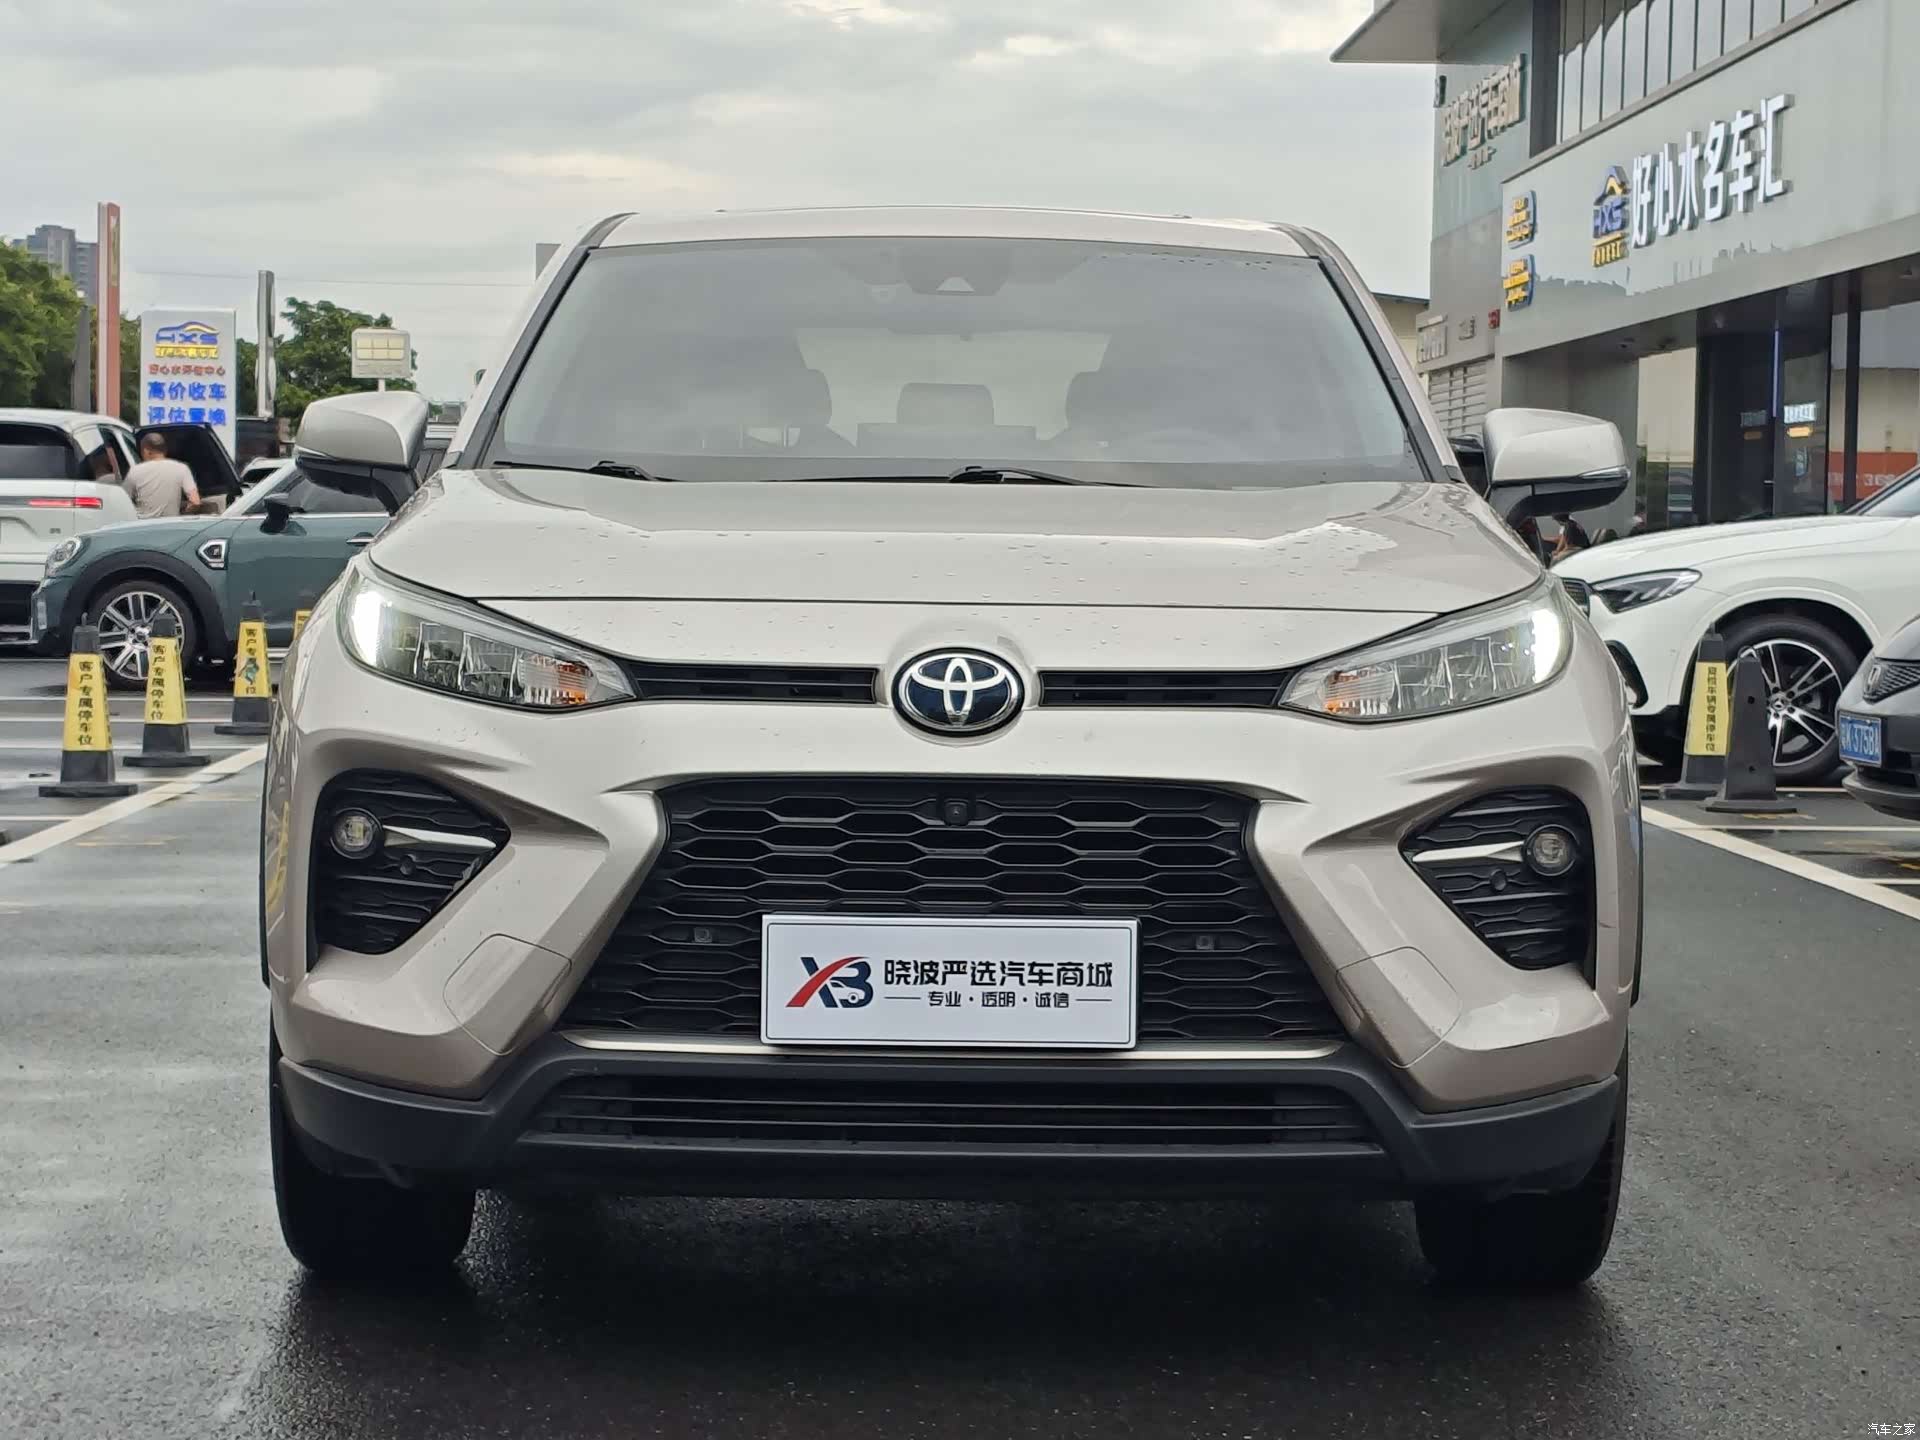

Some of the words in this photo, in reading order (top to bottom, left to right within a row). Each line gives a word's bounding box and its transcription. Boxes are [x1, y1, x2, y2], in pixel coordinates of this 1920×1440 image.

[1632, 94, 1786, 248] 好心水名车汇
[148, 381, 226, 401] 高价收车
[884, 959, 1113, 988] 晓波严选汽车商城
